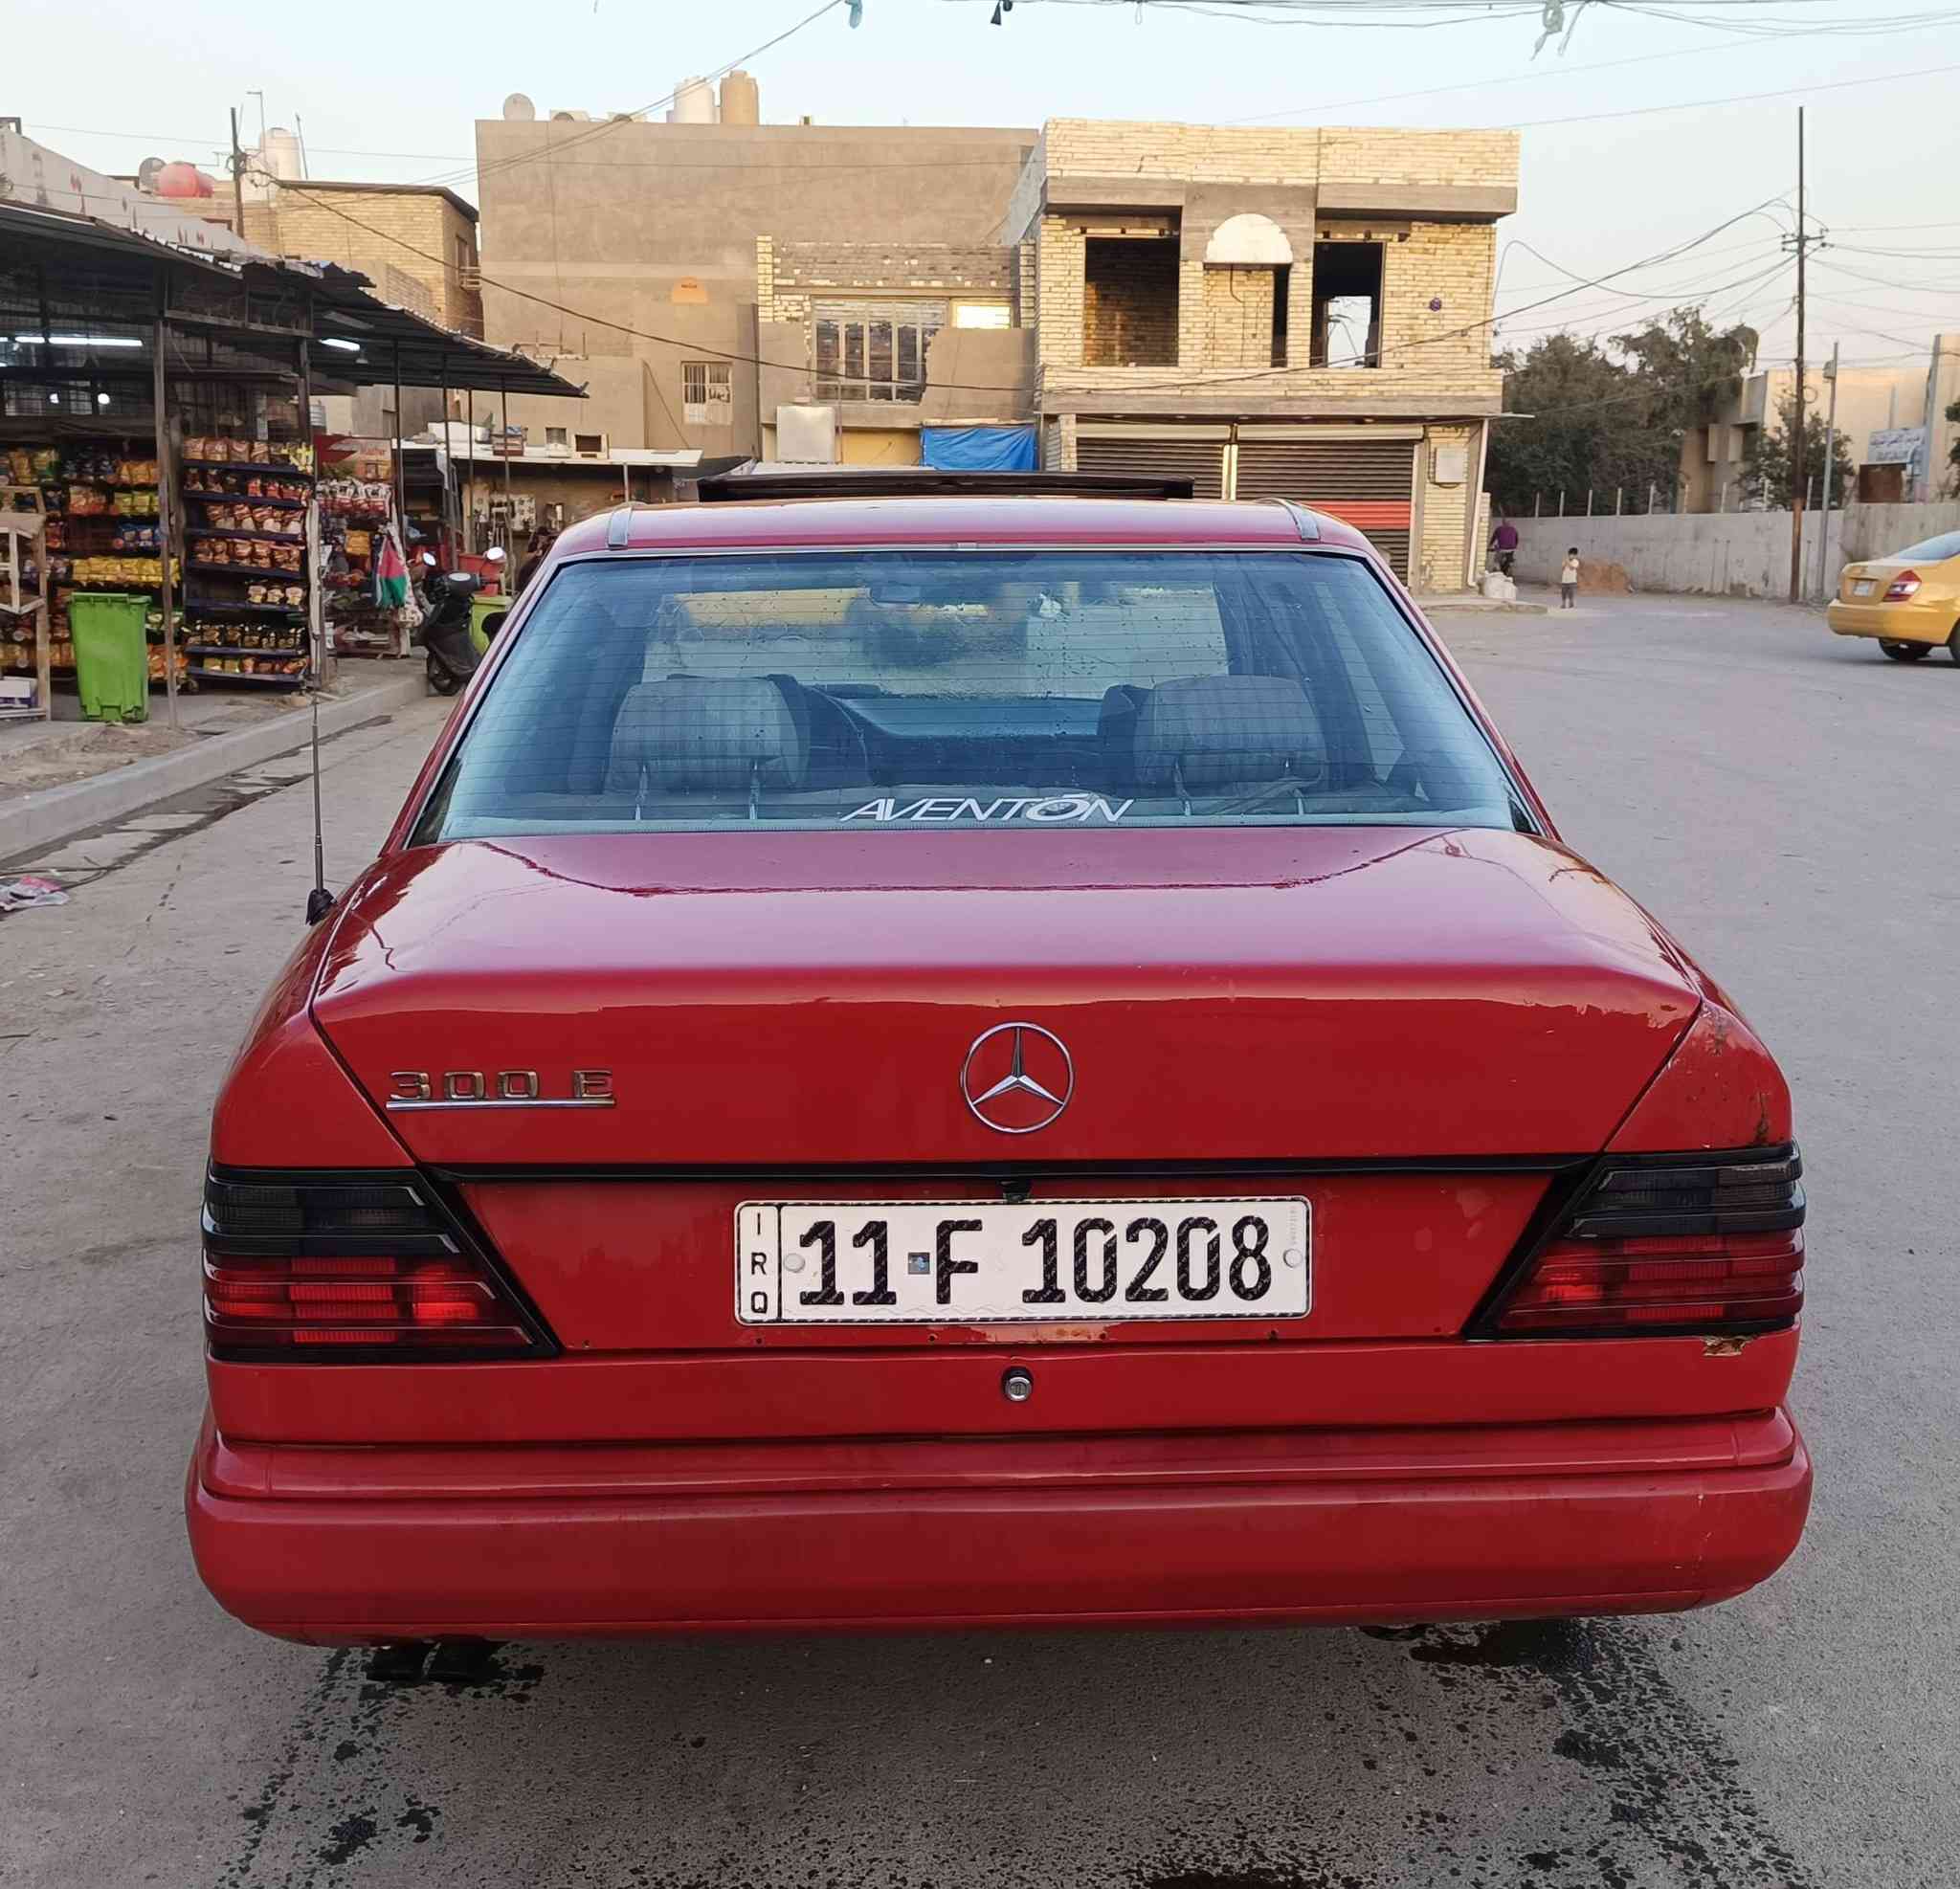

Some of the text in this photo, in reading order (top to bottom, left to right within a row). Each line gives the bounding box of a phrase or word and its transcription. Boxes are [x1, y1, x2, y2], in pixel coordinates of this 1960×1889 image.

[390, 1070, 613, 1100] 300 E
[799, 1219, 899, 1306] 11
[935, 1218, 984, 1305] F
[1021, 1215, 1273, 1304] 10208
